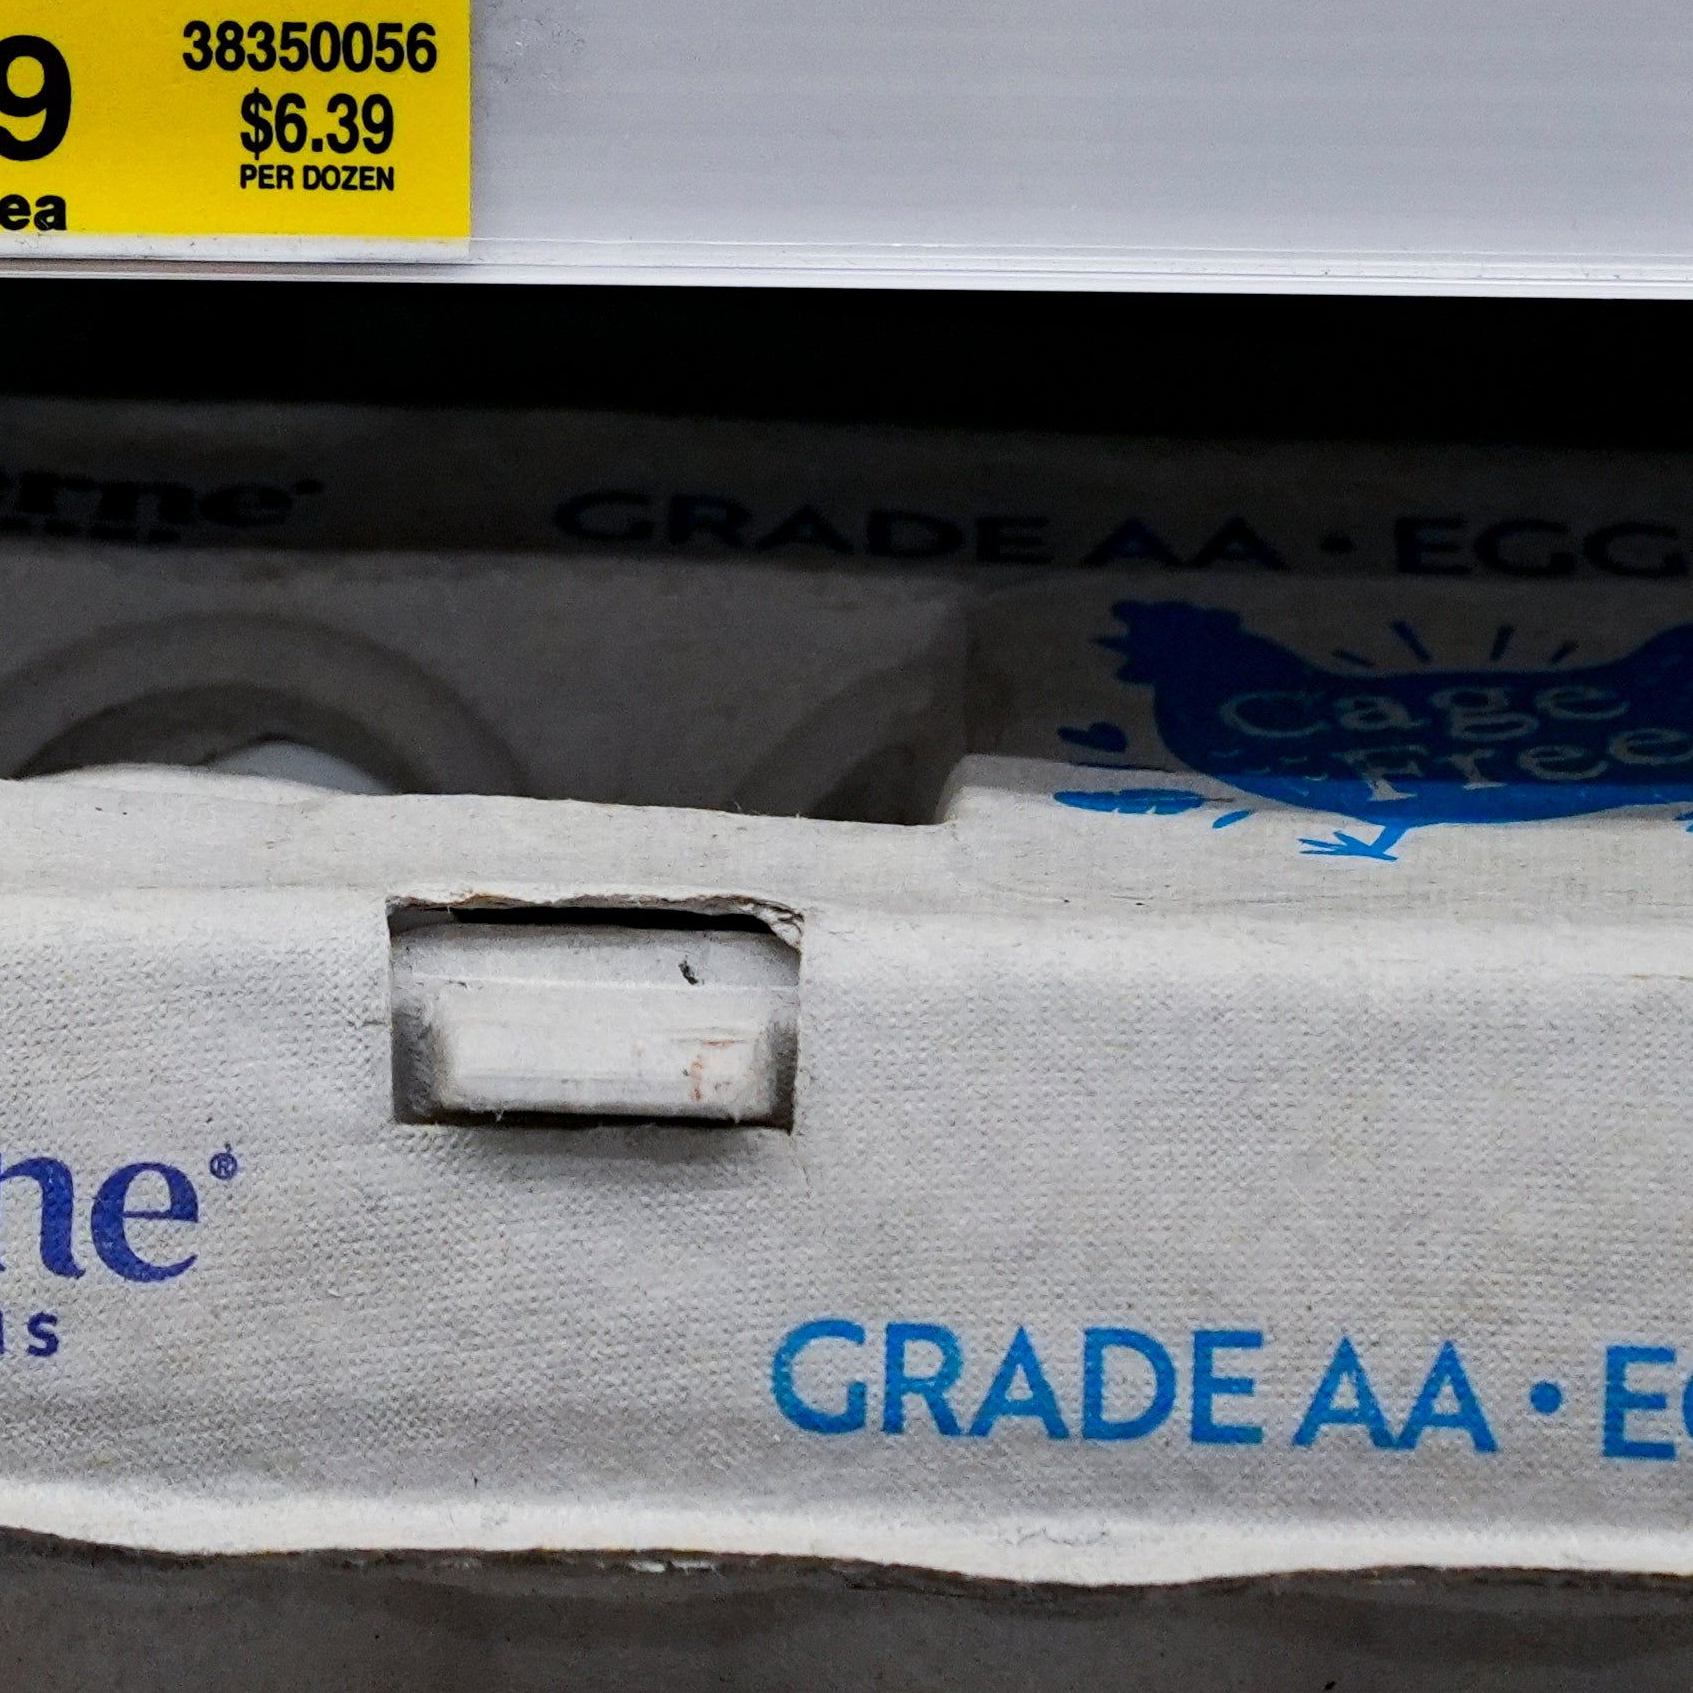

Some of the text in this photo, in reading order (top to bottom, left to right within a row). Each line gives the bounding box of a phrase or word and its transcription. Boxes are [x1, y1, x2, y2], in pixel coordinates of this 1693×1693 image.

[182, 20, 438, 73] 38350056
[240, 88, 394, 160] $6.39
[240, 164, 394, 191] PER DOZEN
[555, 491, 1050, 568] GRADE
[1083, 516, 1287, 571] AA
[1220, 686, 1629, 741] Cage
[1334, 727, 1693, 802] Free
[770, 1319, 1693, 1461] GRADE AA E
